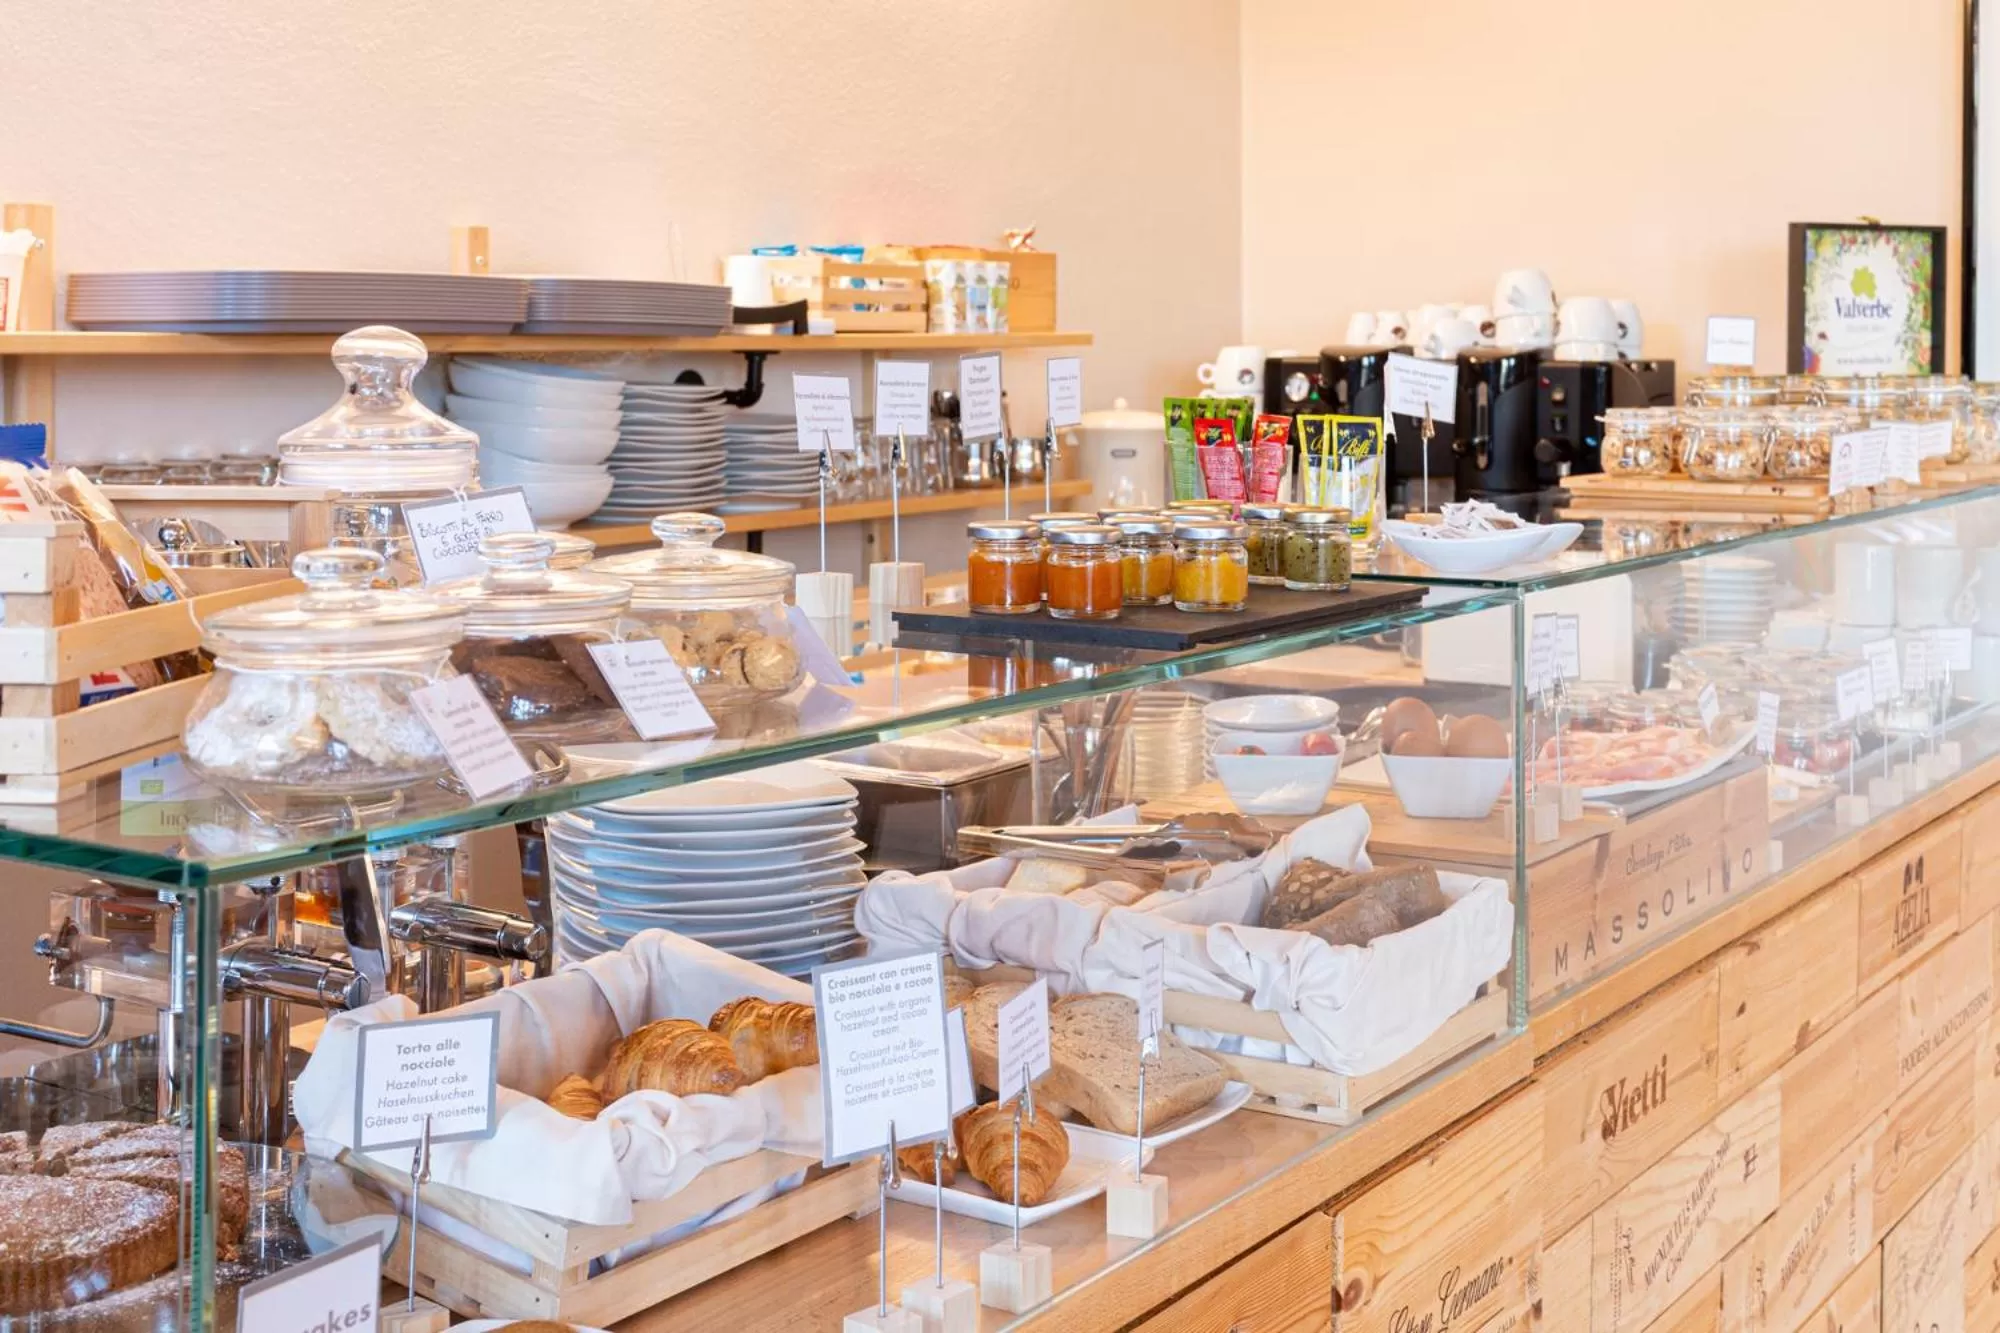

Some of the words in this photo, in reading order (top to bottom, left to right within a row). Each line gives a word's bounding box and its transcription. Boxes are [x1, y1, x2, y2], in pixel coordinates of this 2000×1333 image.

[1835, 296, 1893, 319] Valverbe
[1555, 847, 1753, 977] MASSOLINO
[828, 973, 876, 990] Croissant
[879, 970, 897, 981] con
[900, 963, 932, 976] crema
[827, 992, 846, 1004] bio
[849, 984, 892, 1000] nocciola
[895, 983, 901, 991] e
[904, 977, 934, 989] cacao
[833, 1005, 875, 1022] Croissant
[878, 1000, 896, 1012] with
[898, 995, 932, 1009] organic
[840, 1016, 879, 1032] hazelnut
[881, 1011, 899, 1023] and
[871, 1025, 899, 1037] cream
[396, 1042, 431, 1055] Torta
[435, 1039, 460, 1051] alle
[848, 1046, 890, 1062] Croissant
[400, 1056, 456, 1072] nocciole
[386, 1076, 437, 1091] Hazelnut
[440, 1072, 468, 1084] cake
[844, 1077, 885, 1095] Croissant
[896, 1071, 905, 1083] la
[881, 1088, 890, 1099] et
[920, 1078, 936, 1090] bio
[376, 1088, 474, 1108] Haselnusskuchen
[1600, 1053, 1668, 1146] Vietti
[364, 1113, 408, 1128] Gâteau
[436, 1103, 486, 1119] noisettes
